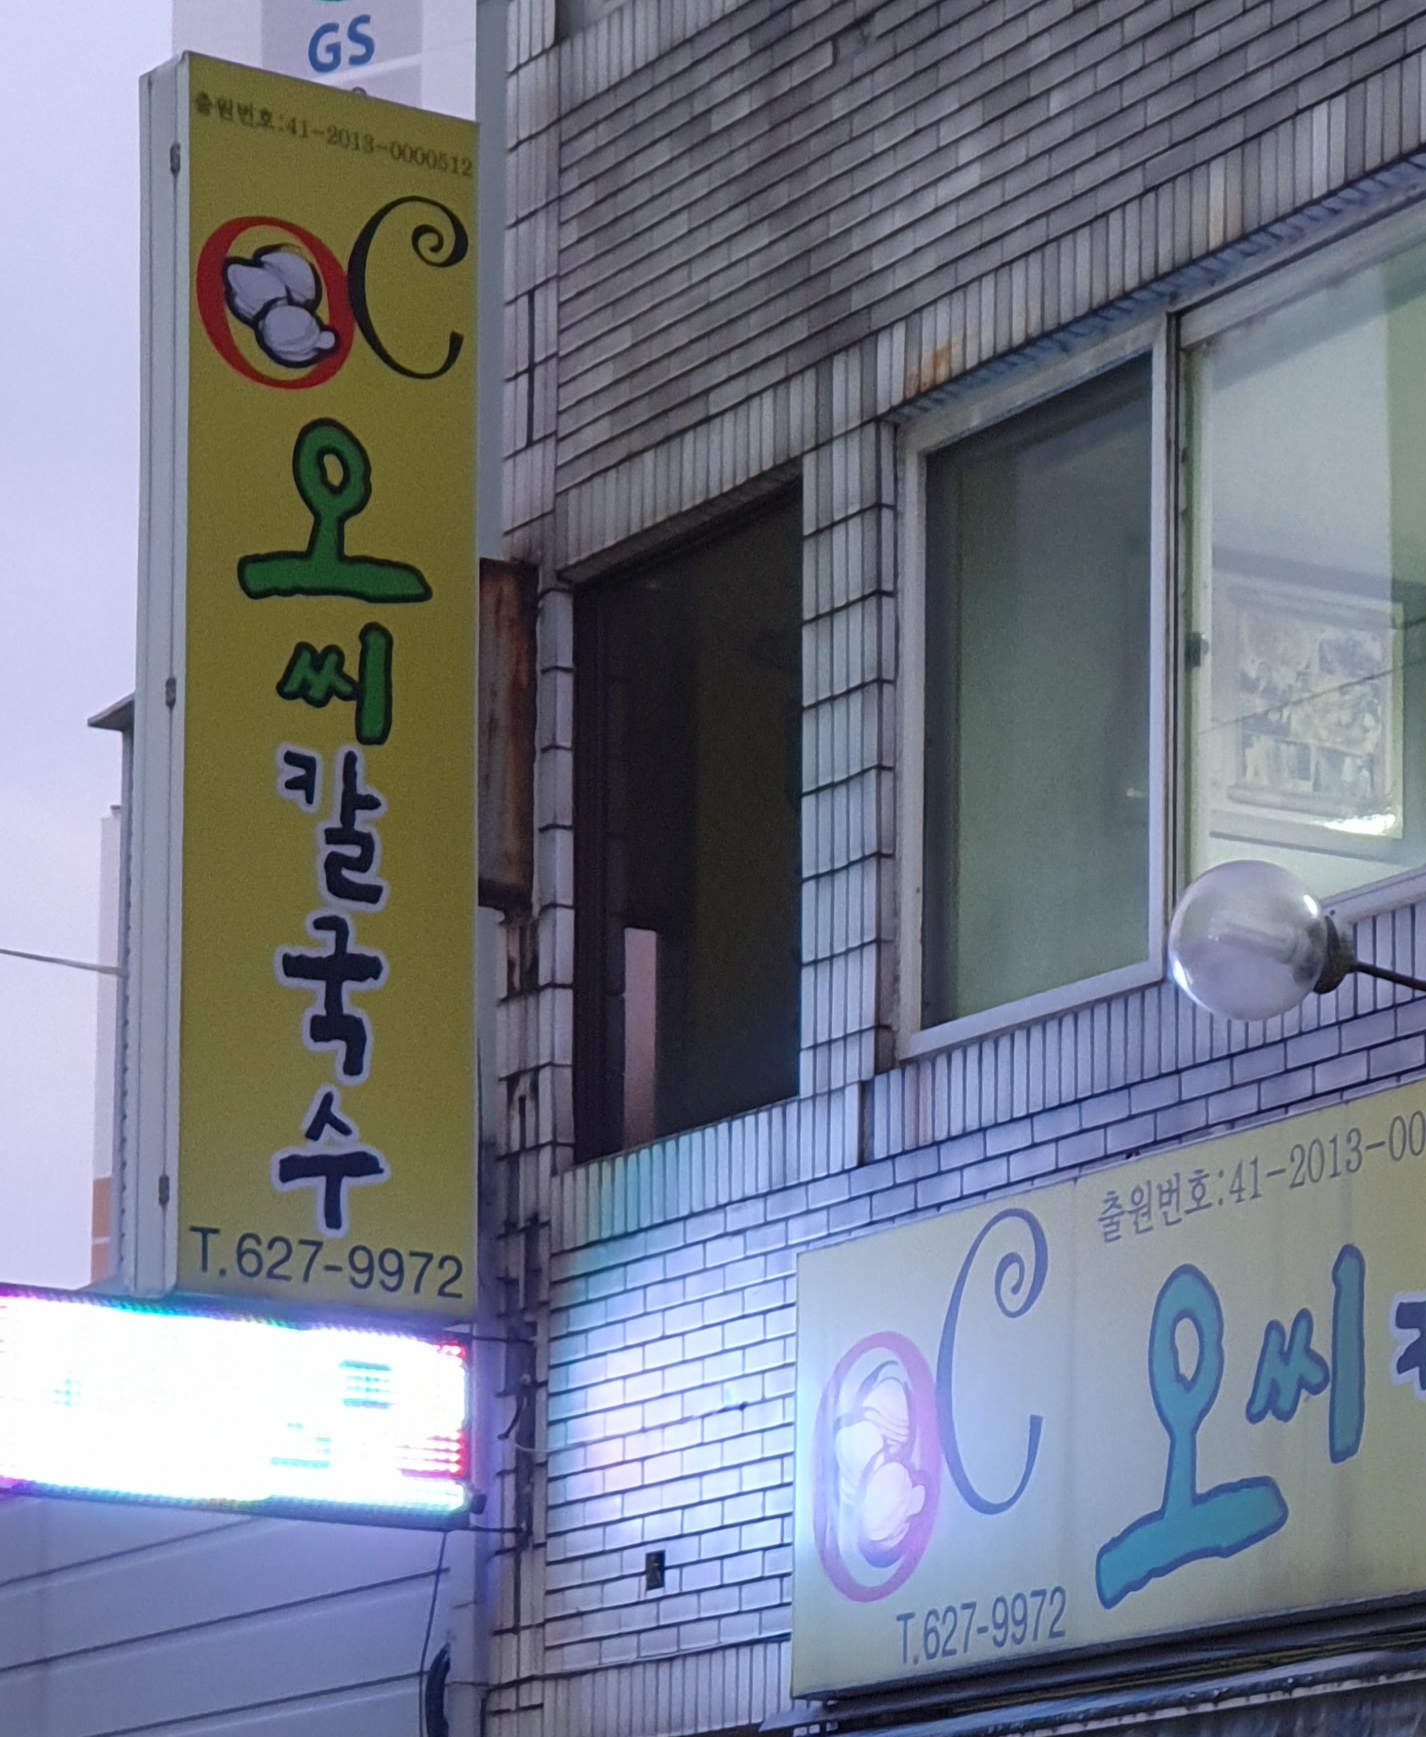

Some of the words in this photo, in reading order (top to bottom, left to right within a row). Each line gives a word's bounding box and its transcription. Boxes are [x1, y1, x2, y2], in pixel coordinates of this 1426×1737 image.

[307, 14, 375, 73] GS
[236, 417, 433, 1230] 오씨칼국수
[188, 1226, 464, 1300] T.627-9972
[897, 1586, 1066, 1666] T.627-9972
